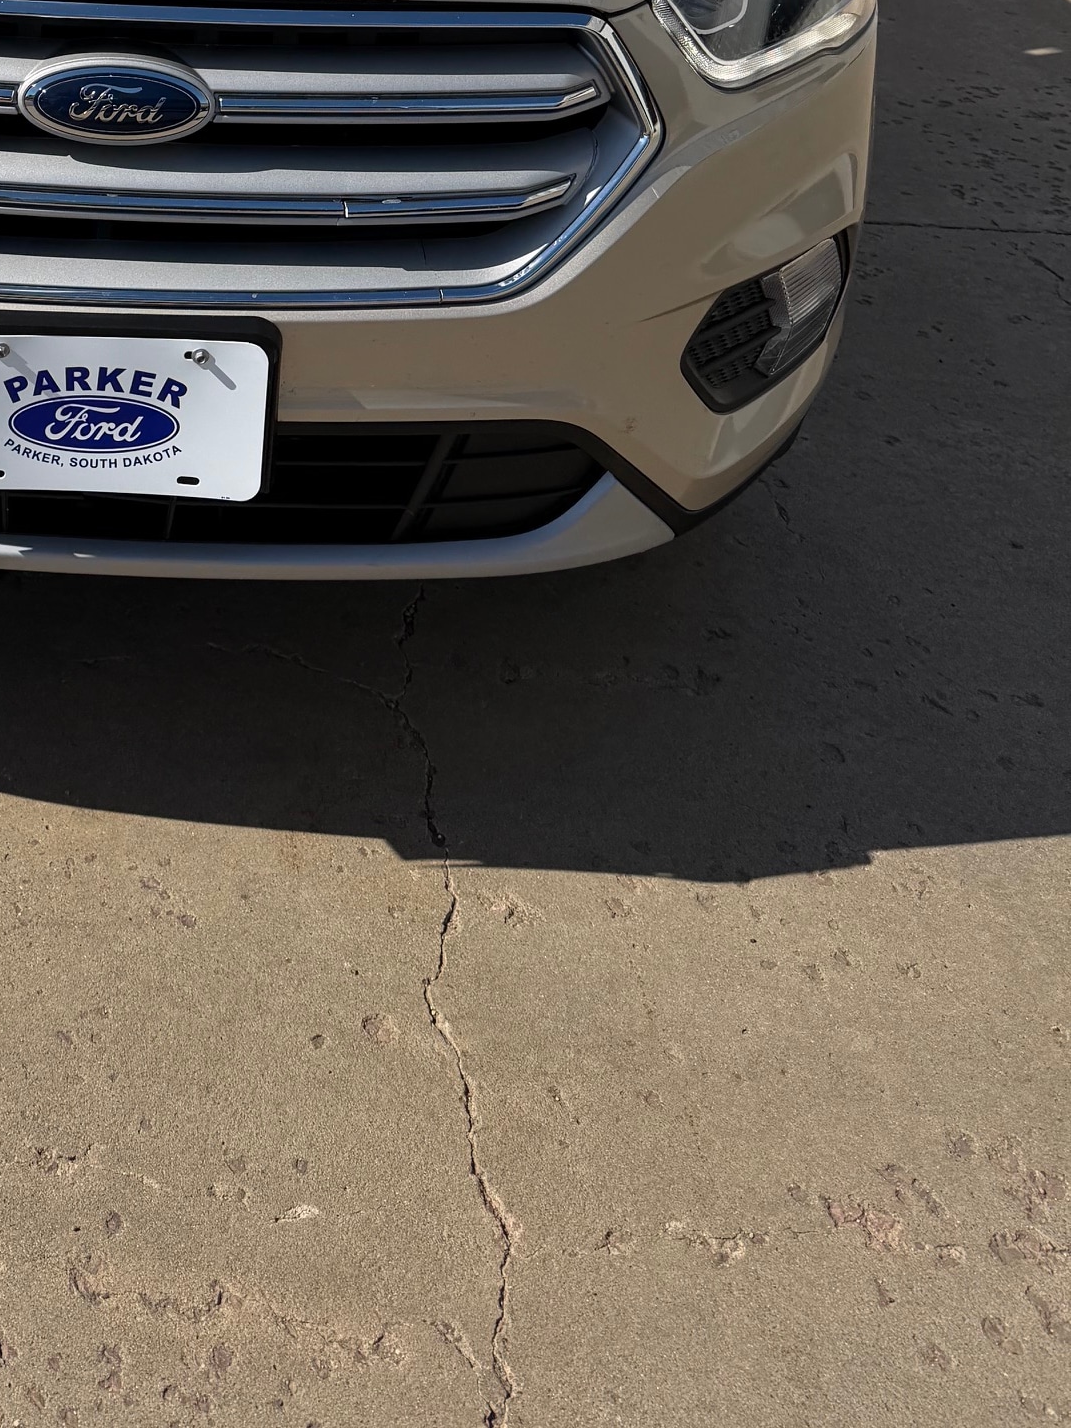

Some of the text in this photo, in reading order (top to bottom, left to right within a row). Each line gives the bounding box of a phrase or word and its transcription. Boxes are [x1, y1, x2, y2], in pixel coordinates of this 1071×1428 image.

[68, 83, 167, 124] Ford
[3, 366, 188, 410] PARKER
[44, 403, 144, 443] Ford
[3, 438, 183, 469] PARKER, SOUTH DAKOTA
